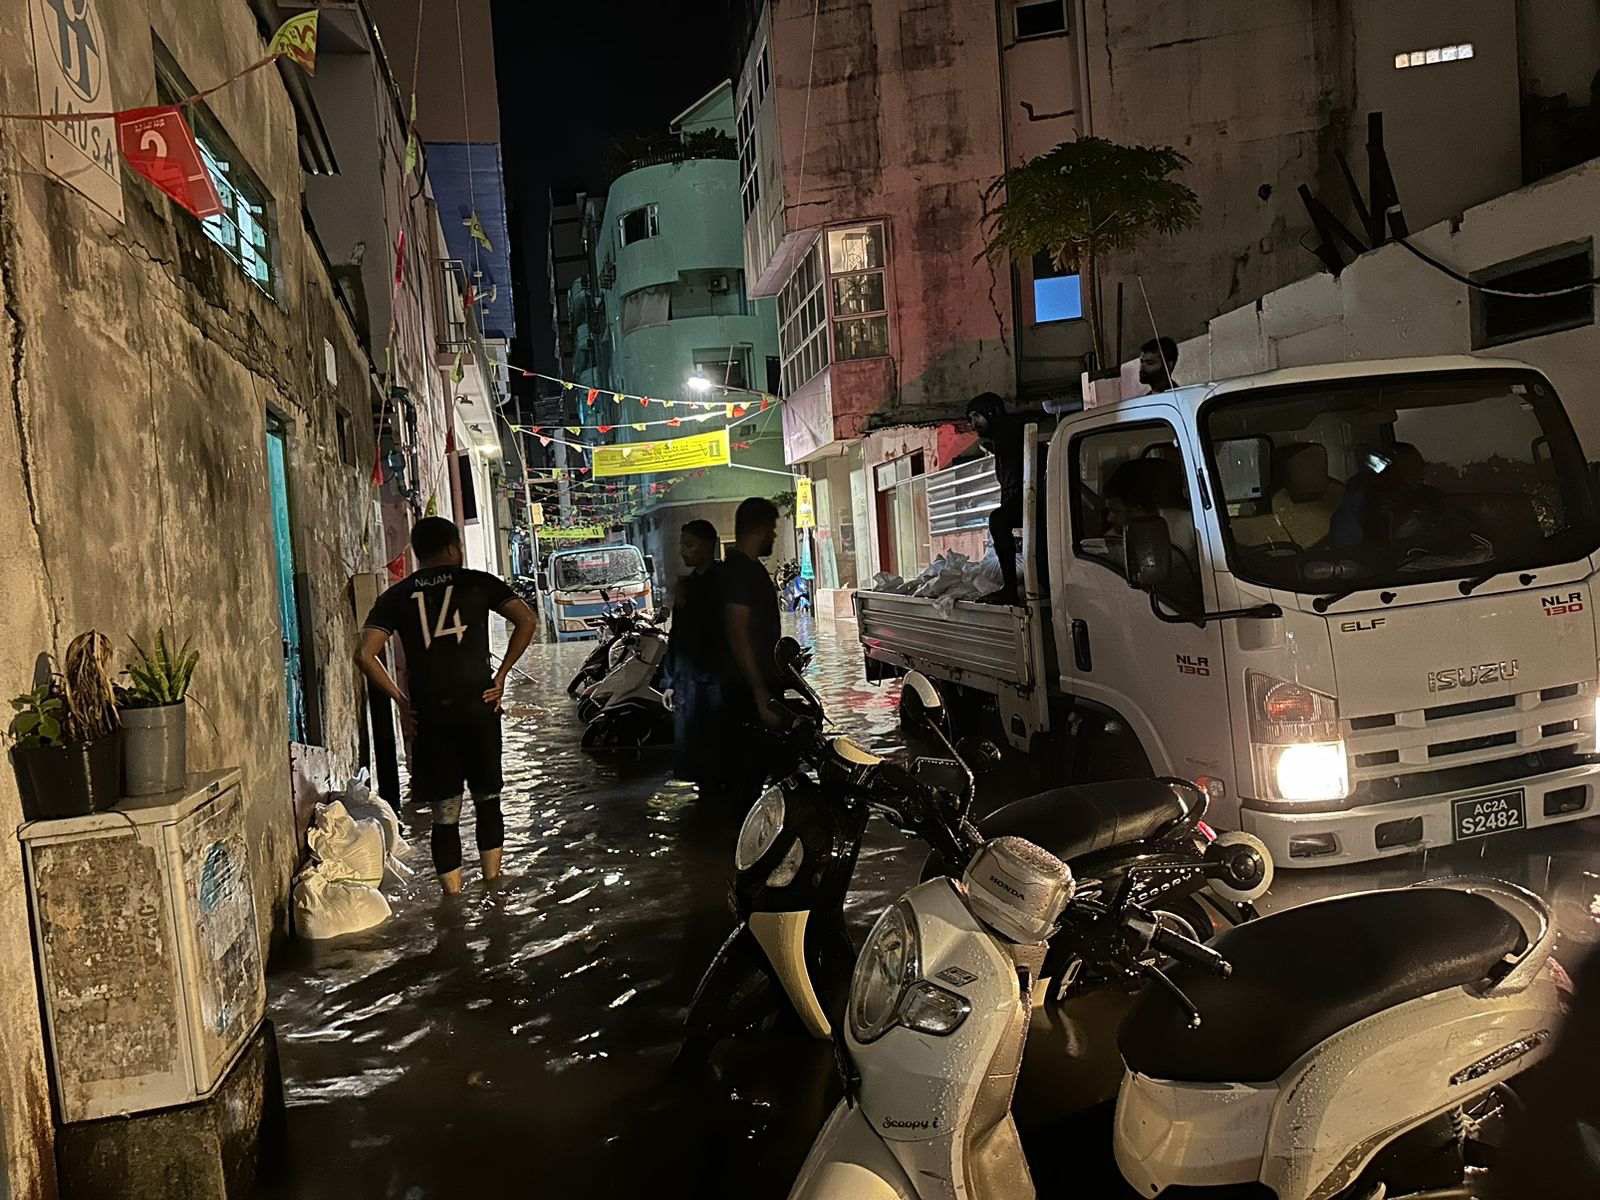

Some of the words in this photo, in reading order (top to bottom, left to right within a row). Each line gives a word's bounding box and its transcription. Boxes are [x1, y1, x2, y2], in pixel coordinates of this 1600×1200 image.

[1541, 591, 1582, 608] NLR
[409, 585, 470, 651] 14
[1543, 603, 1584, 616] 130
[1340, 618, 1386, 633] ELF
[1176, 654, 1209, 667] NLR
[1177, 665, 1210, 676] 130
[1428, 659, 1519, 693] ISUZU
[1474, 798, 1508, 815] AC2A
[1461, 809, 1519, 834] S2482
[990, 874, 1027, 901] HONDA
[883, 1116, 929, 1130] Scoopy
[932, 1116, 939, 1128] i
